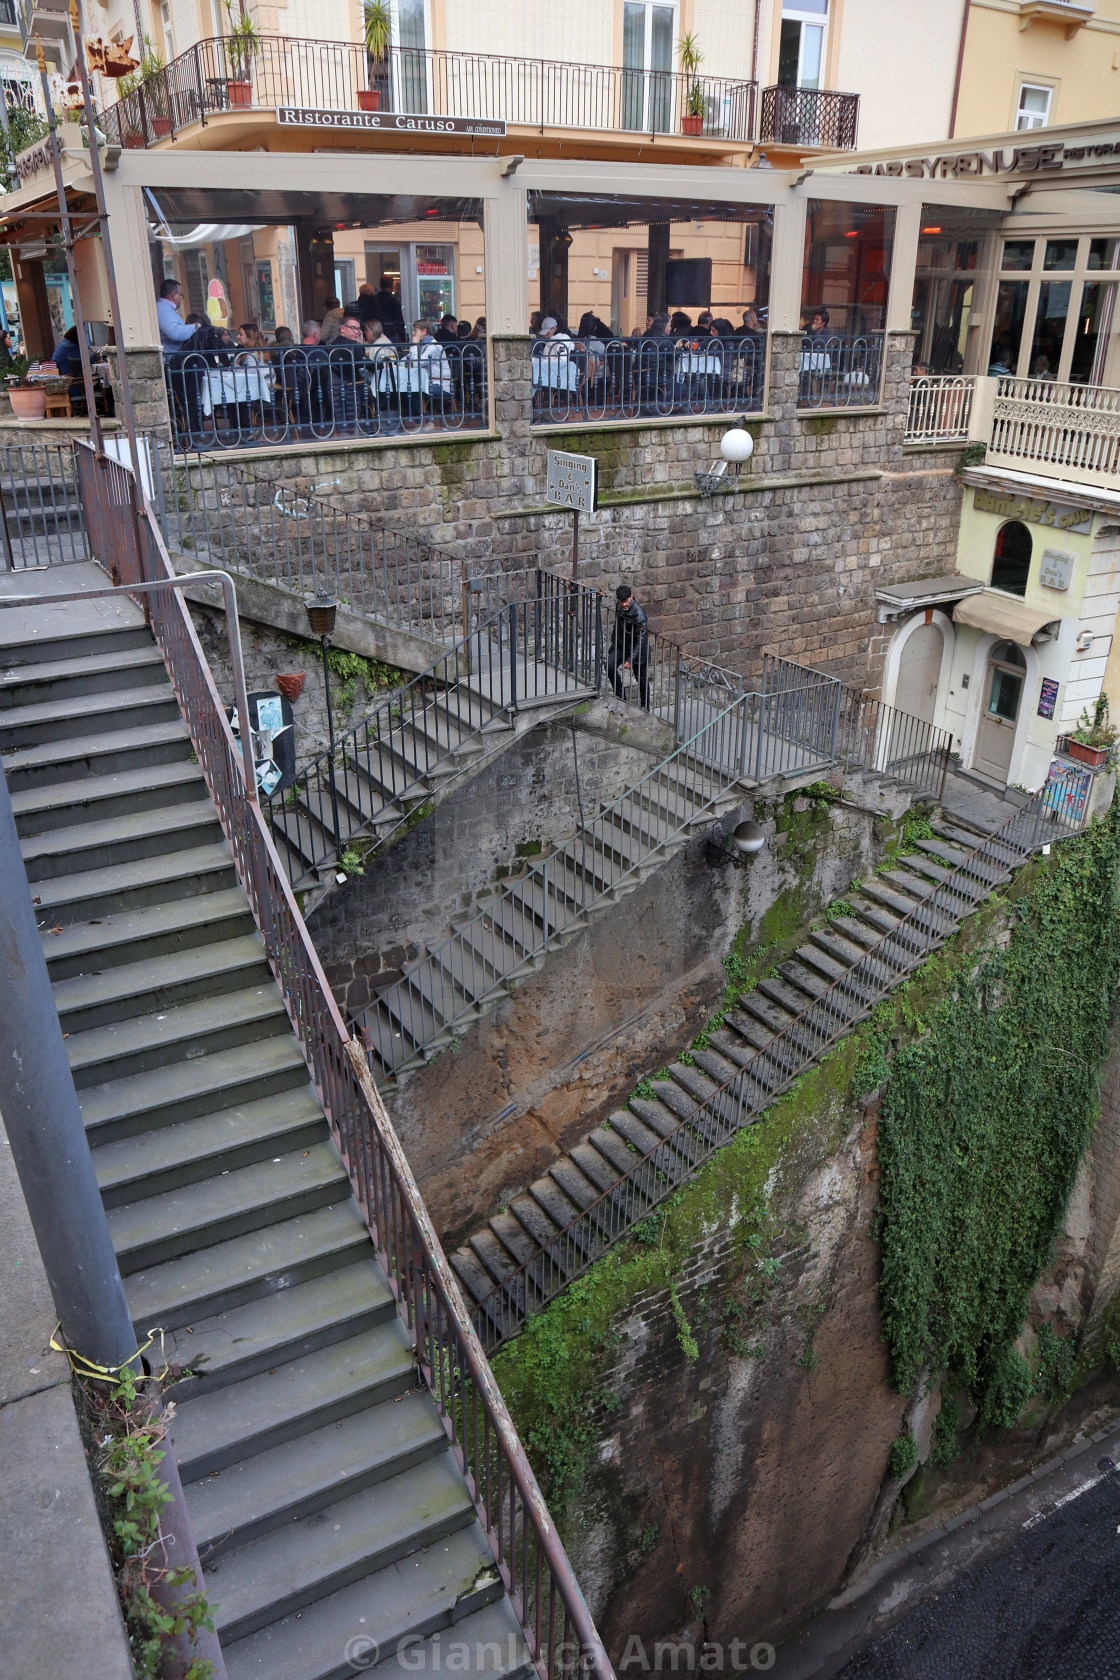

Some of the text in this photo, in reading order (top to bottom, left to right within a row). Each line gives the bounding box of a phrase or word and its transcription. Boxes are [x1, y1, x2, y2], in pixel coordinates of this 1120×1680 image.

[284, 110, 455, 132] Ristorante Caruso
[554, 455, 587, 473] Singing
[558, 479, 582, 493] Dan's
[1044, 551, 1069, 564] Singing
